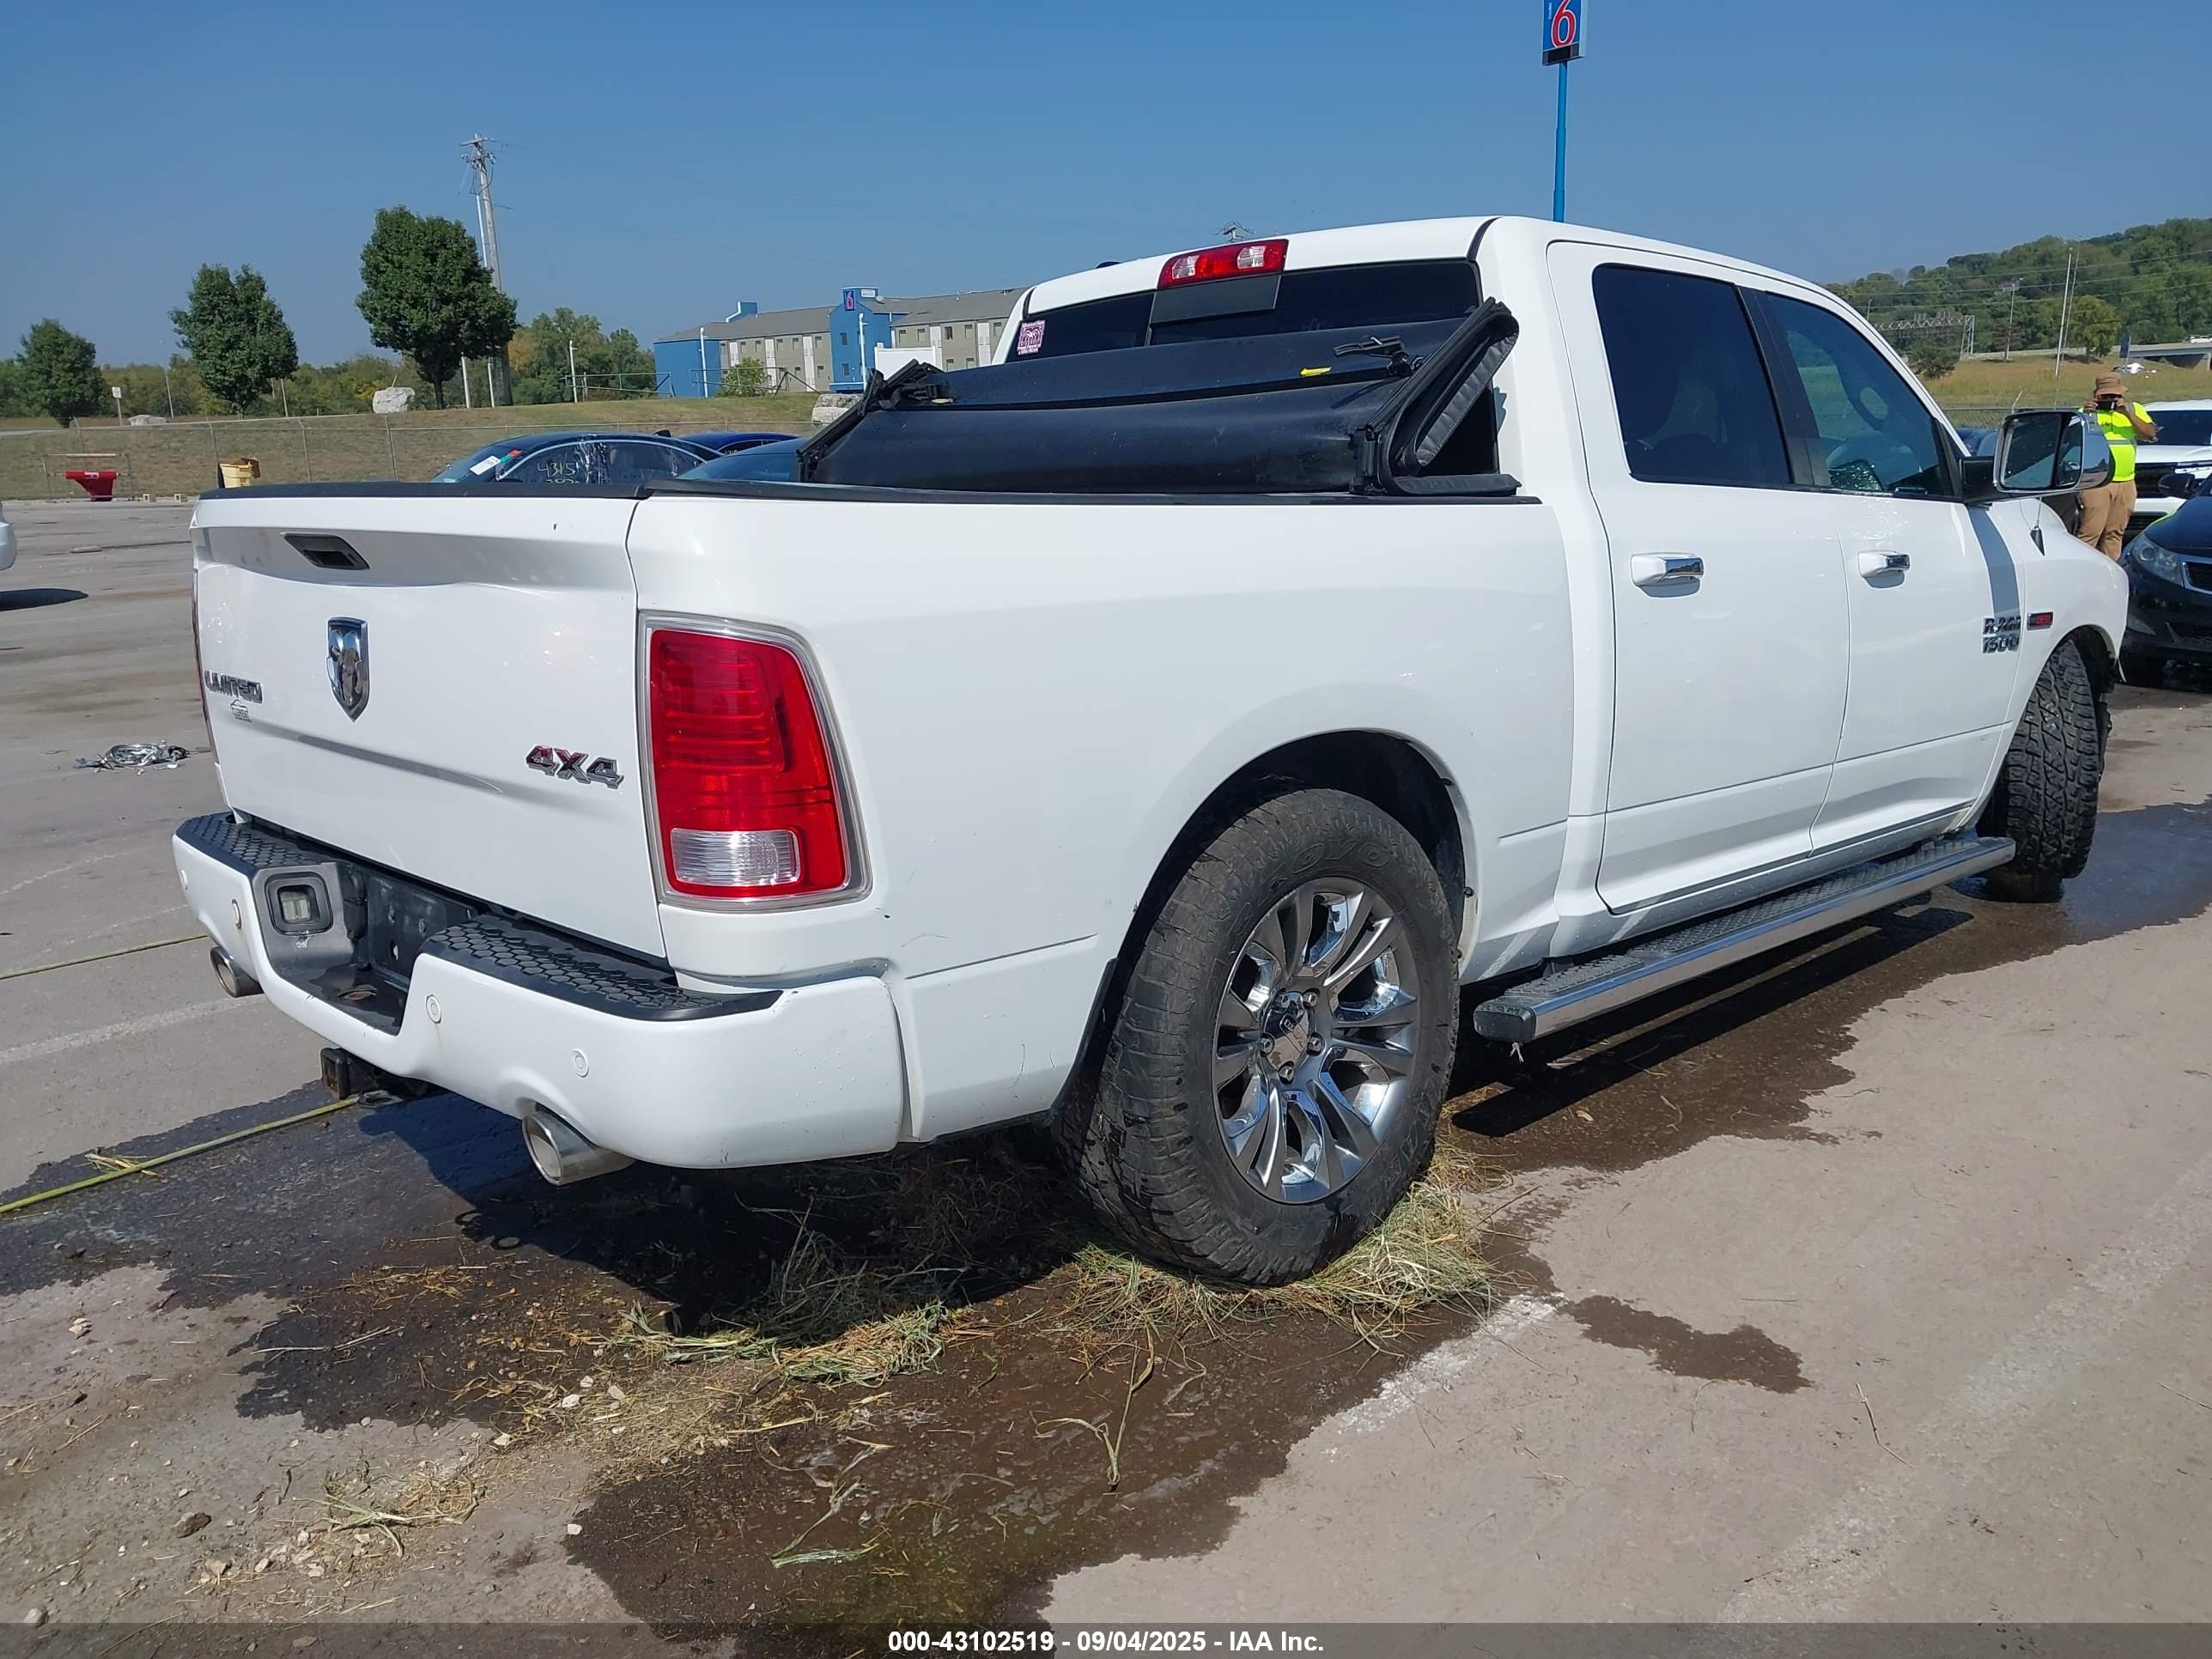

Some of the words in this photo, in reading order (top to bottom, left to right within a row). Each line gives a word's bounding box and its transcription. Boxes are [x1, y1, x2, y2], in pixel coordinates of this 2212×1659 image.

[1551, 0, 1577, 48] 6
[1983, 616, 2021, 635] RAM
[1982, 634, 2020, 653] 1500
[204, 670, 263, 704] LIMITED
